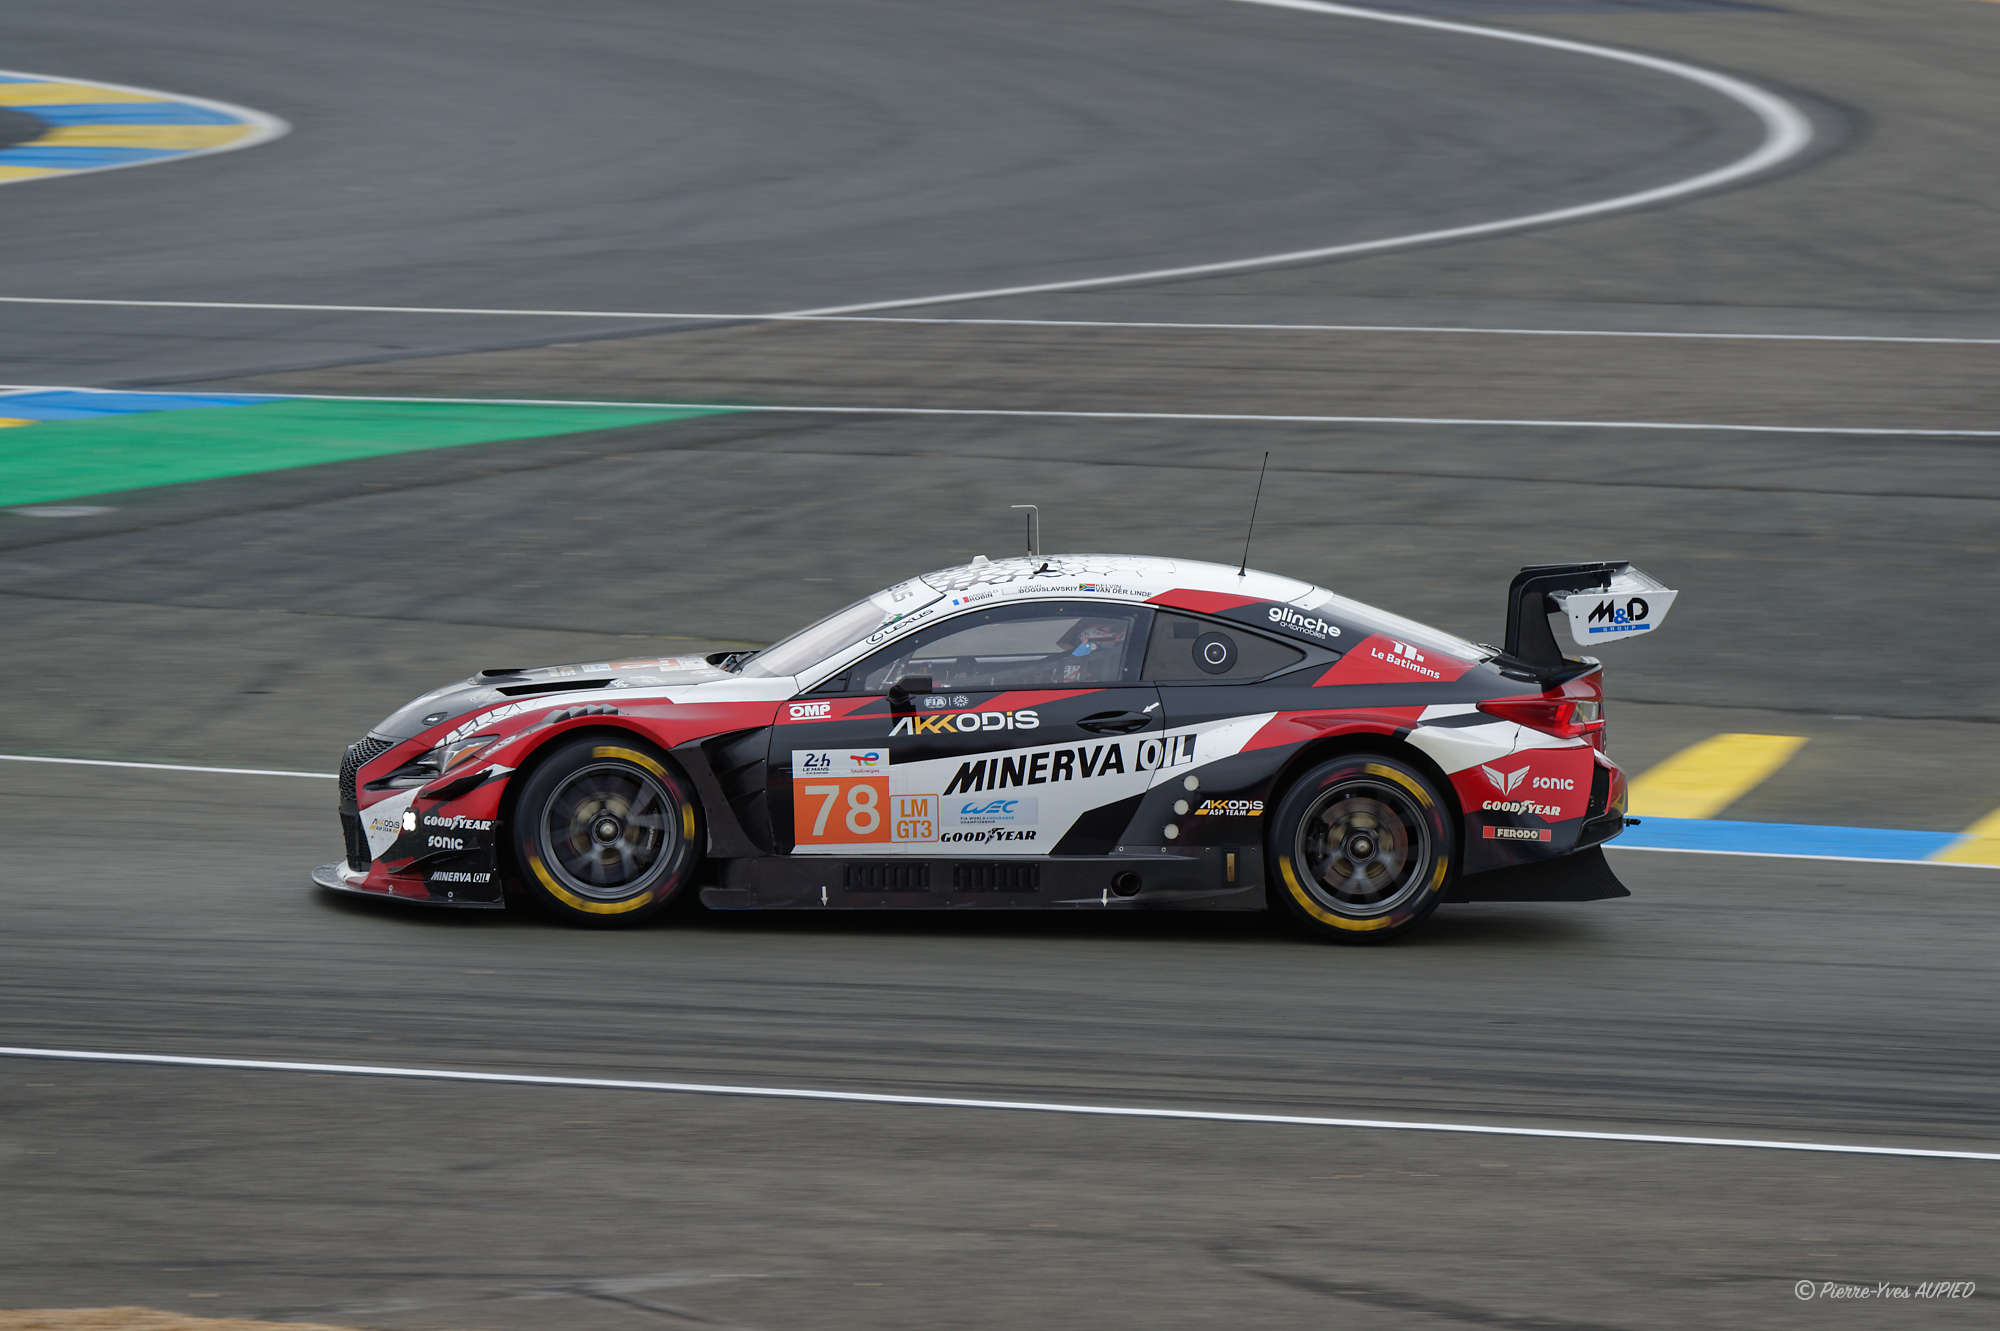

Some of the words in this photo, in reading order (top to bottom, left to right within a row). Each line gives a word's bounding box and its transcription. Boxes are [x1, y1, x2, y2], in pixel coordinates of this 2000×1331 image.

[1130, 589, 1152, 598] LINDE
[1588, 597, 1649, 624] M&D
[884, 609, 934, 634] LEXUS
[1268, 607, 1341, 637] glinche
[1280, 621, 1326, 640] automobiles
[1371, 647, 1384, 659] Le
[1386, 652, 1441, 679] Batimans
[789, 703, 831, 718] OMP
[925, 697, 946, 708] FIA
[943, 743, 1125, 796] MINERVA
[1137, 735, 1197, 771] OIL
[804, 784, 880, 836] 78
[900, 799, 928, 818] LM
[961, 800, 1019, 814] WEC
[896, 820, 933, 839] GT3
[1497, 828, 1538, 839] FERODO
[430, 871, 472, 882] MINERVA
[473, 873, 491, 883] OIL
